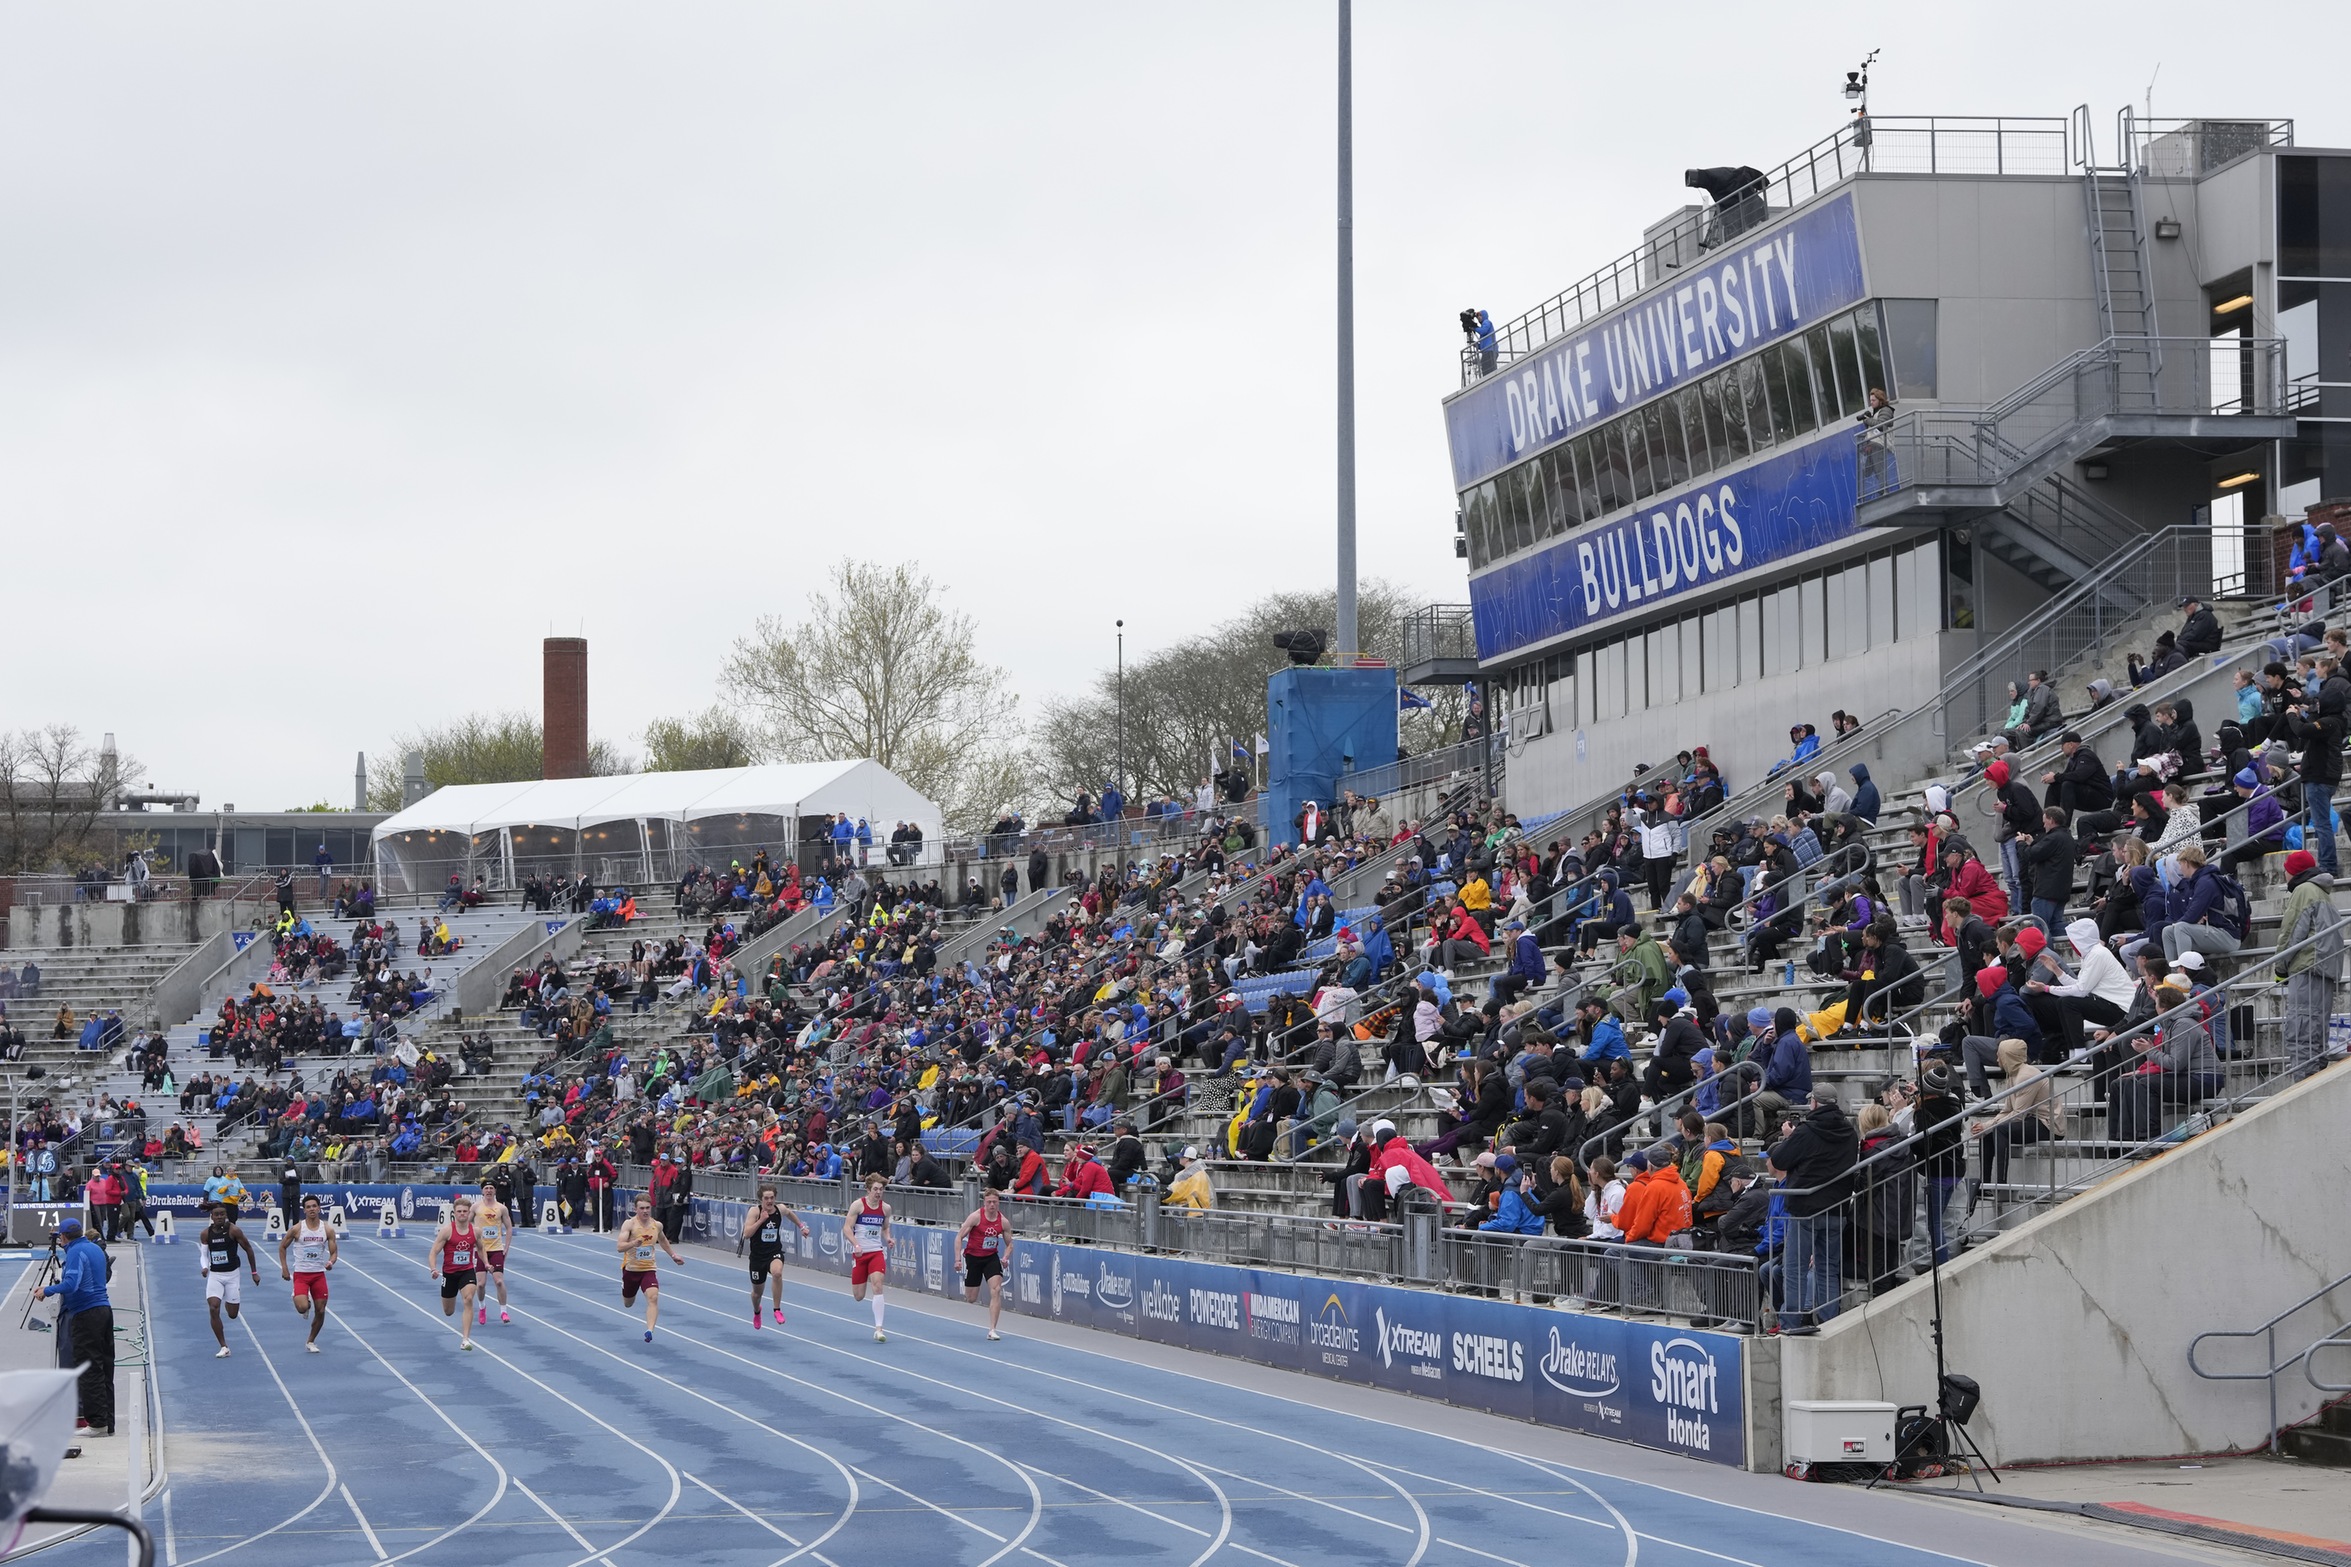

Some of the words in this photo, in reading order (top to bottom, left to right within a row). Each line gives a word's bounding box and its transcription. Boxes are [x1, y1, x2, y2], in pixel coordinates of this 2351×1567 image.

[1505, 341, 1599, 453] DRAKE
[1604, 232, 1799, 404] UNIVERSITY
[1578, 484, 1743, 617] BULLDOGS
[145, 1194, 204, 1208] @DrakeRelays
[357, 1196, 396, 1207] XTREAM
[439, 1211, 445, 1224] 6
[546, 1208, 556, 1222] 8
[37, 1211, 60, 1227] 7.1
[161, 1218, 168, 1231] 1
[270, 1215, 280, 1229] 3
[332, 1213, 342, 1227] 4
[385, 1212, 394, 1225] 5
[1100, 1261, 1117, 1296] Drake
[1141, 1279, 1180, 1323] wellabe
[1190, 1289, 1239, 1330] POWERADE
[1250, 1293, 1300, 1324] MIDAMERICAN
[1251, 1317, 1271, 1341] ENERGY
[1271, 1322, 1300, 1346] COMPANY
[1310, 1309, 1360, 1352] broadlawns
[1391, 1323, 1441, 1359] XTREAM
[1452, 1331, 1524, 1382] SCHEELS
[1549, 1326, 1585, 1379] Drake
[1586, 1351, 1617, 1384] RELAYS
[1651, 1340, 1718, 1414] Smart
[1667, 1407, 1710, 1451] Honda
